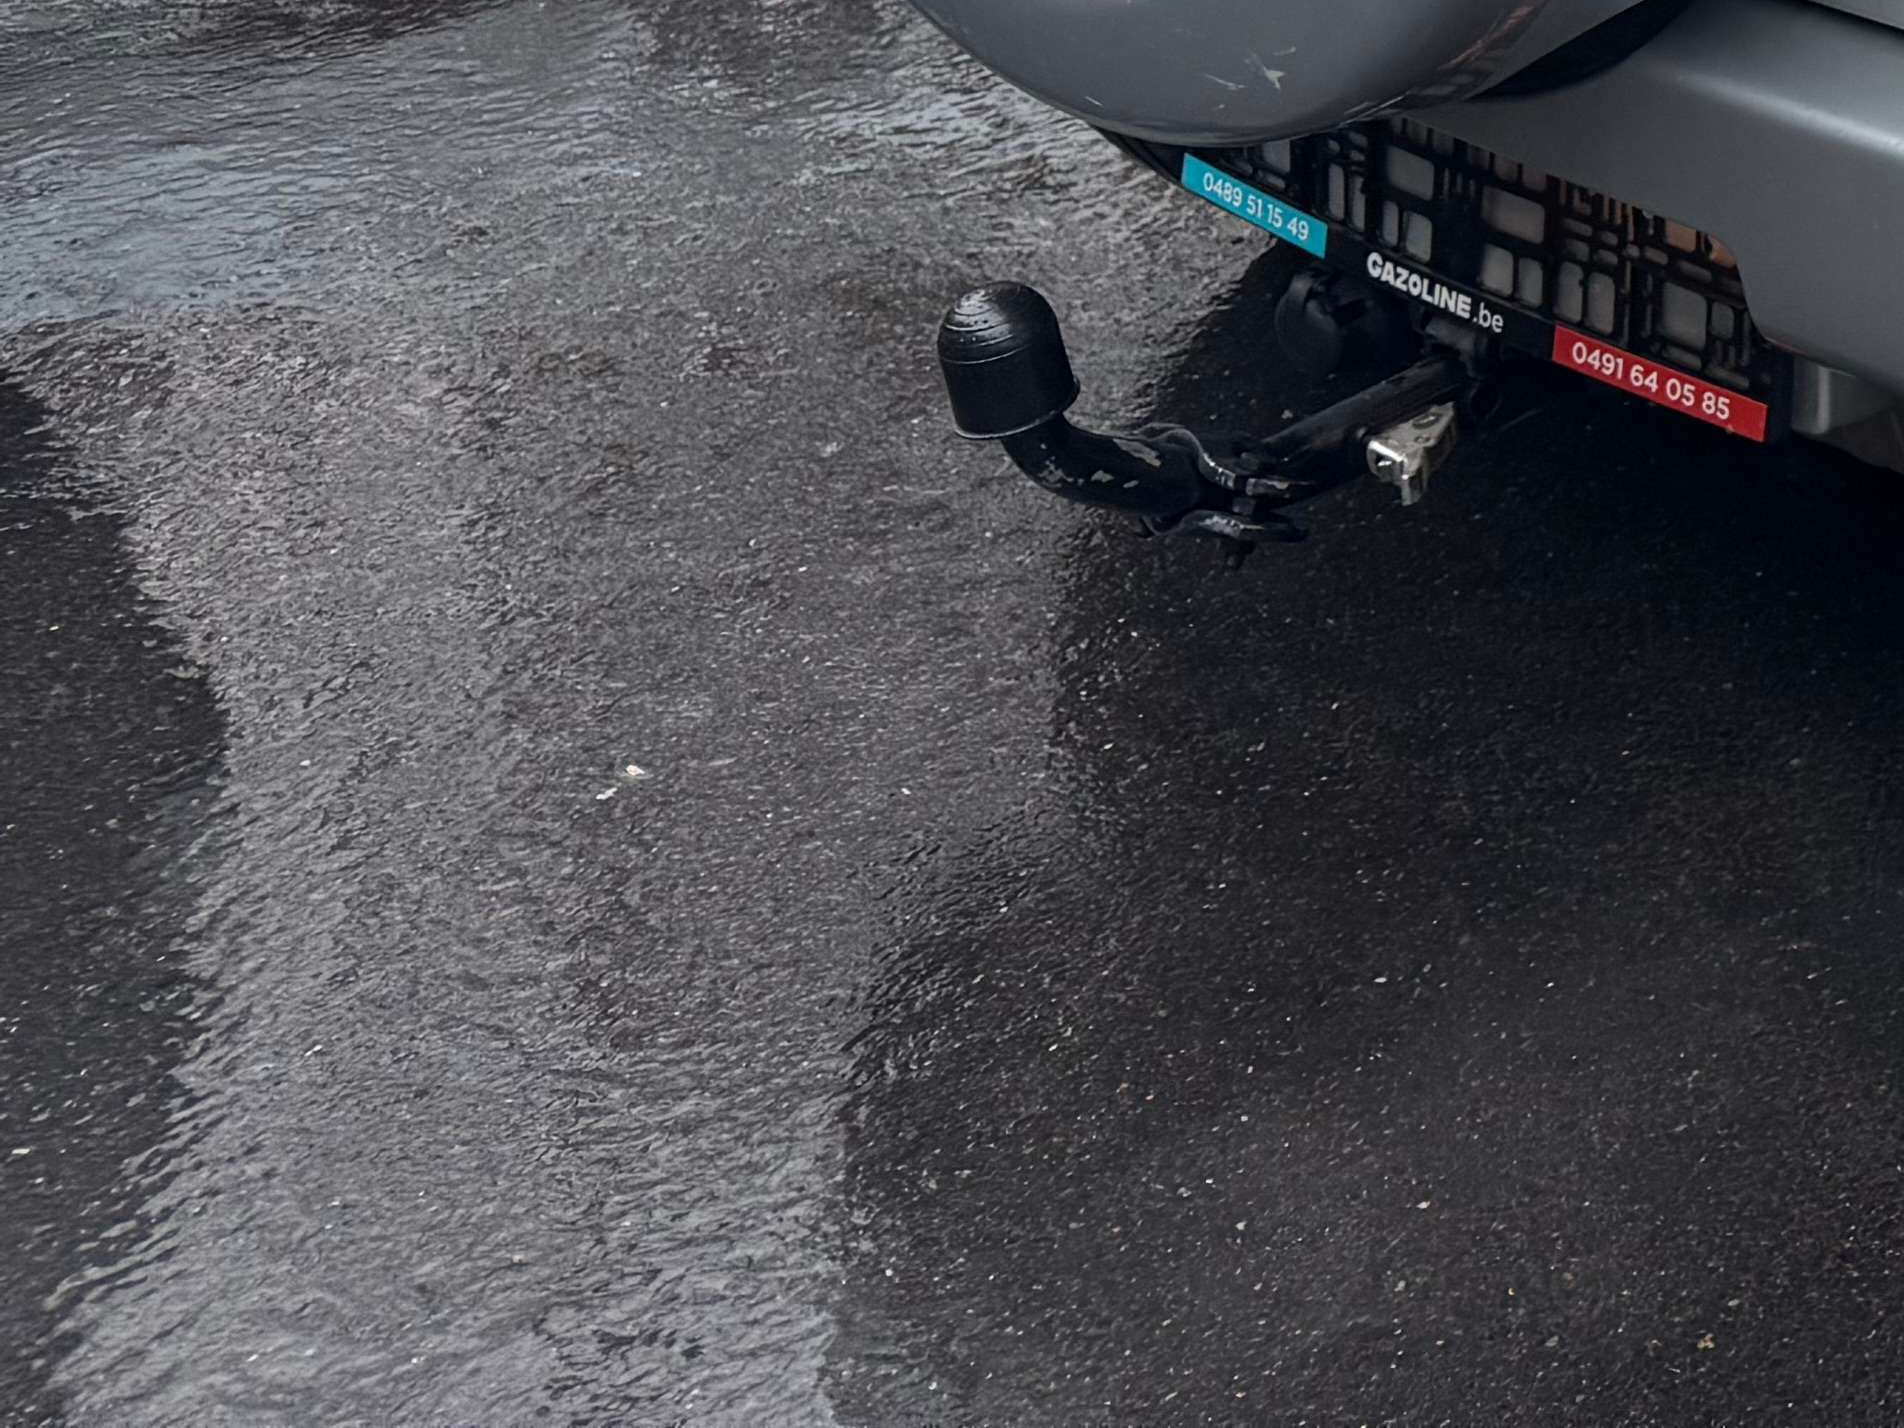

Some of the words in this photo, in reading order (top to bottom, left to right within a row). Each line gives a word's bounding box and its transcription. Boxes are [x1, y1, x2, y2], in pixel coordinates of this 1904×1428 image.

[1203, 172, 1243, 207] 0489
[1246, 195, 1263, 219] 51
[1267, 202, 1284, 228] 15
[1287, 216, 1310, 241] 49
[1366, 251, 1505, 333] GAZOLINE.be
[1572, 341, 1625, 380] 0491
[1630, 364, 1659, 393] 64
[1665, 378, 1696, 407] 05
[1701, 391, 1731, 420] 85
